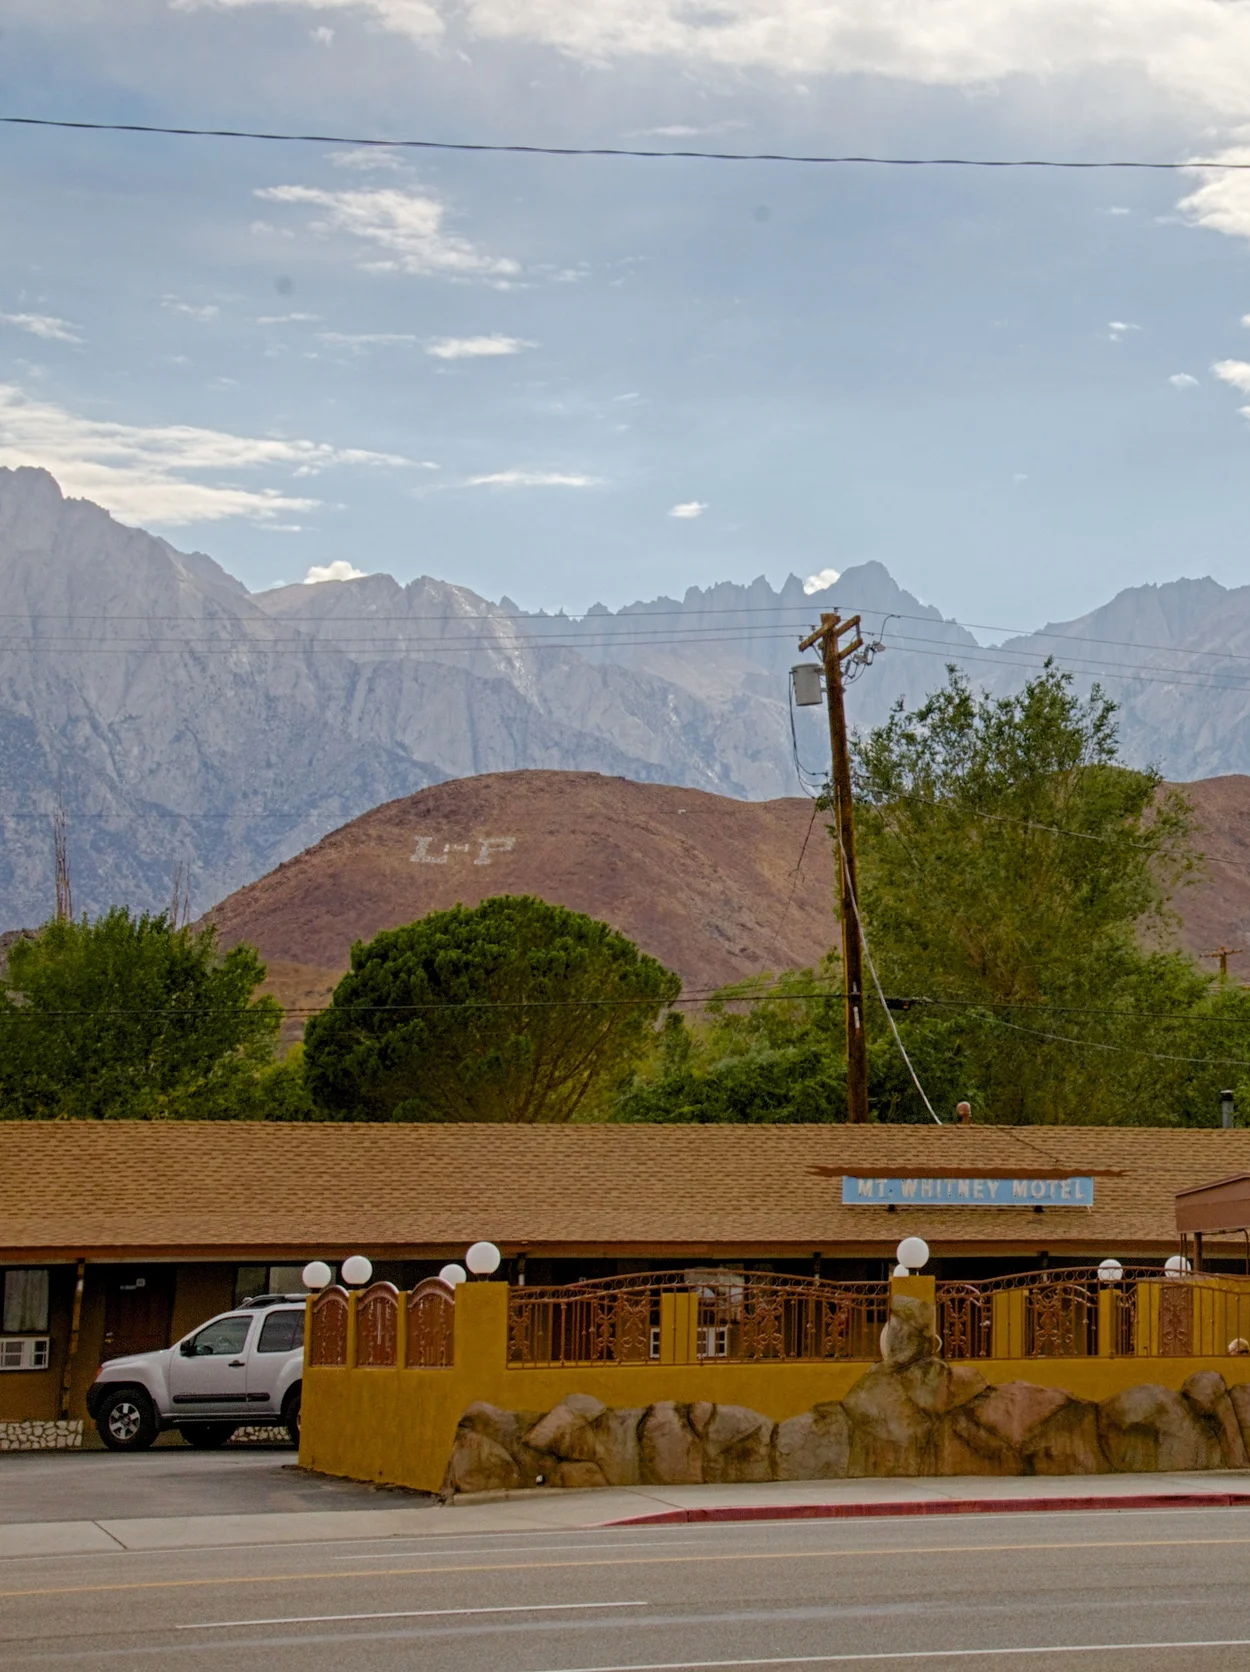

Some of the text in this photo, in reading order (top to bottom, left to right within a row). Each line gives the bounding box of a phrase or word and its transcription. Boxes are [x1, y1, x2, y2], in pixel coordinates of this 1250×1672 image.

[858, 1178, 1084, 1199] MT. WHITNEY MOTEL
